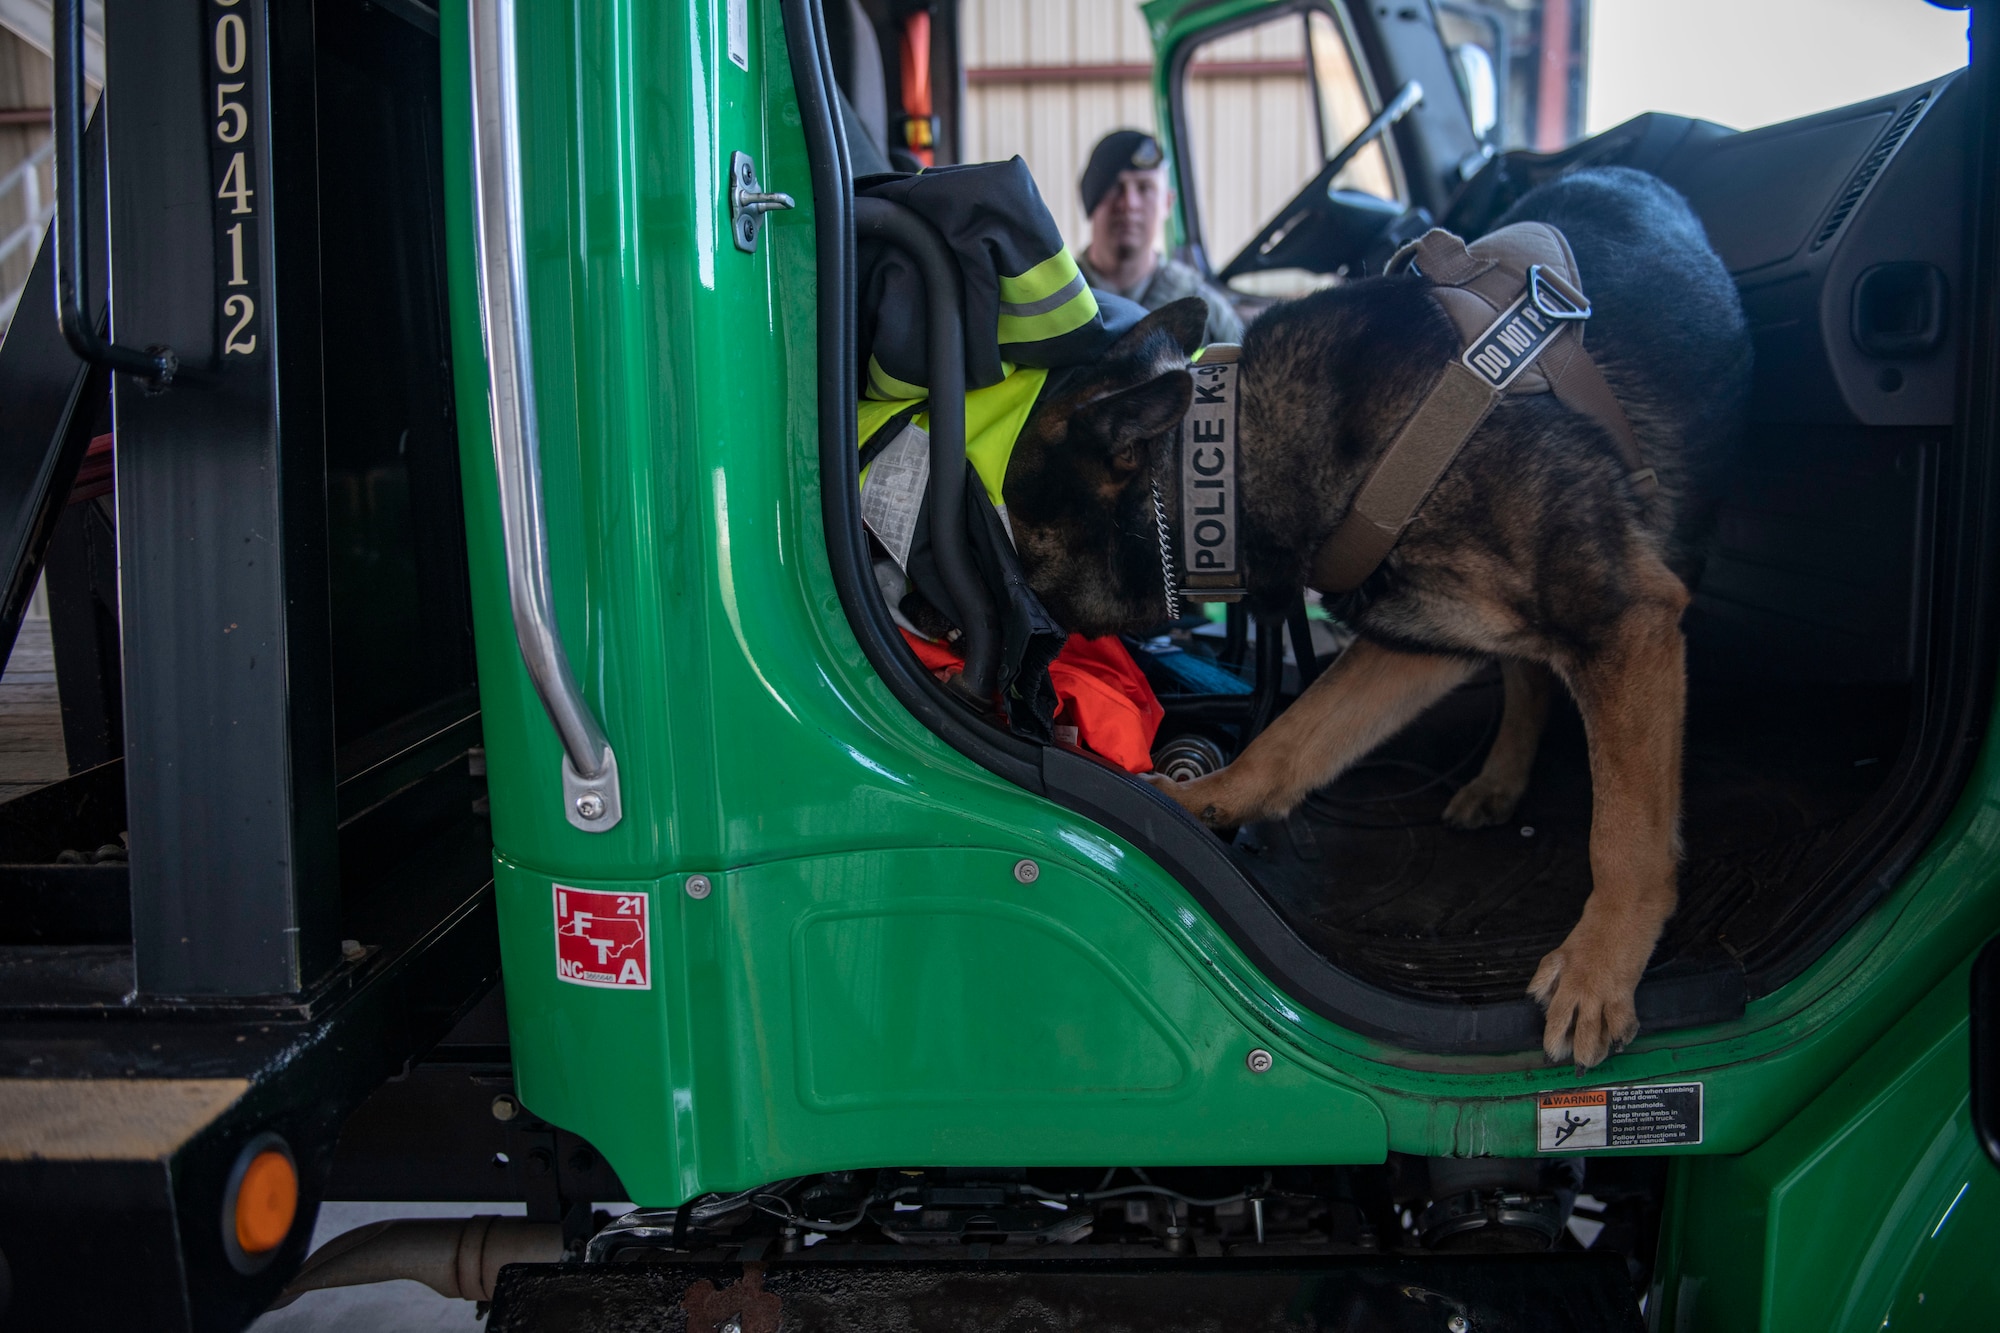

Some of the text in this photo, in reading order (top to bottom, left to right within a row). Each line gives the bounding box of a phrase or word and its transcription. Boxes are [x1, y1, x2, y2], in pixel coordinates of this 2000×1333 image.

[214, 0, 257, 355] 05412
[1473, 292, 1562, 380] DO NOT PT
[1192, 365, 1228, 569] POLICE K-9
[616, 897, 641, 915] 21
[560, 958, 583, 979] NC
[1553, 1094, 1604, 1105] WARNING
